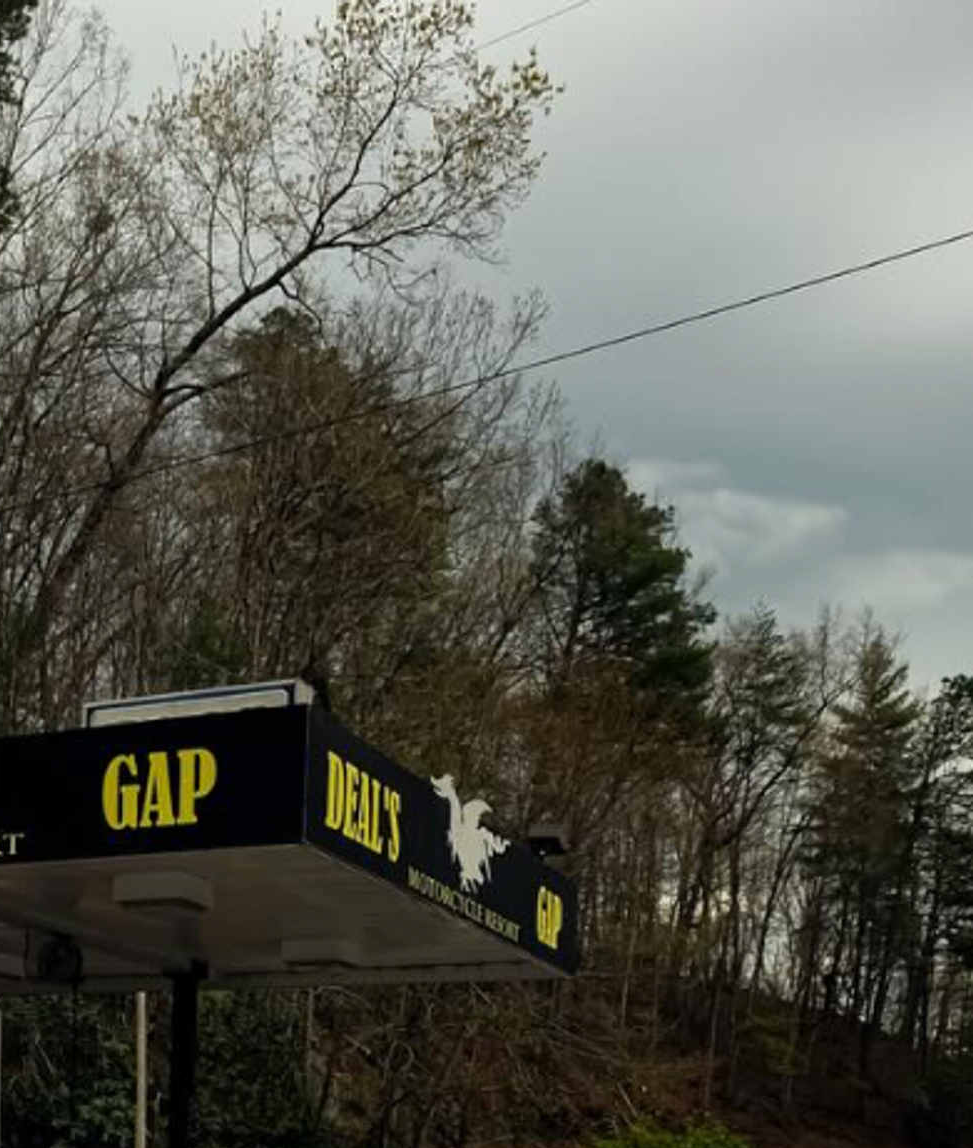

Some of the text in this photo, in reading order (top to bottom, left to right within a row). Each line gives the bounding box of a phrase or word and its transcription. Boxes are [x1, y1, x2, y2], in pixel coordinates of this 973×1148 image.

[102, 748, 218, 831] GAP
[325, 750, 402, 864] DEAL'S
[407, 866, 483, 925] MOTORCYCLE
[537, 884, 563, 950] GAP
